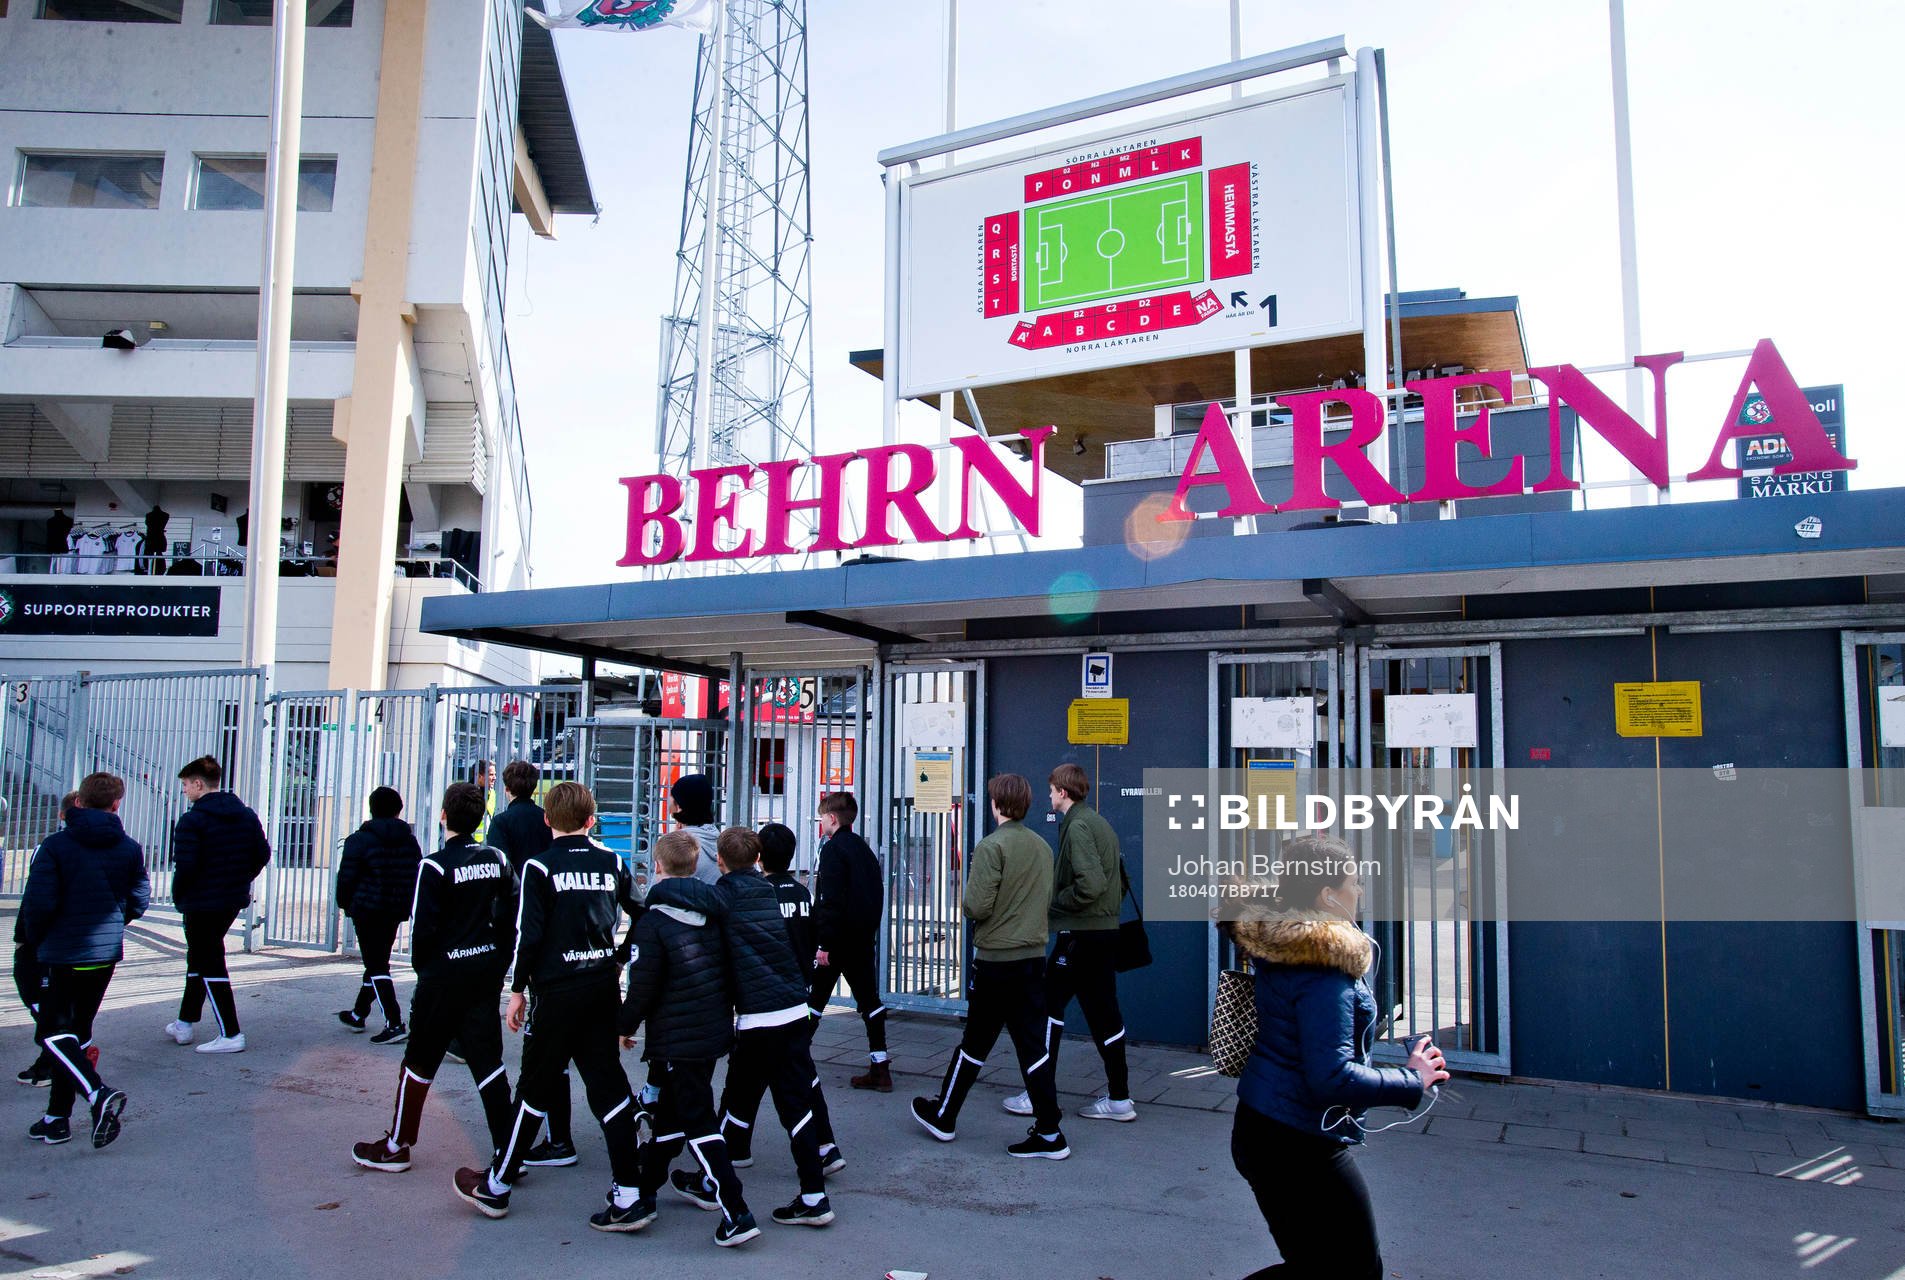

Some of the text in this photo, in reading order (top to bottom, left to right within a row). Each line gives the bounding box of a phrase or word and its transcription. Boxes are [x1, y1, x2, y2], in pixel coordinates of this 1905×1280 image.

[1035, 149, 1191, 192] P O N M L K
[992, 223, 1001, 234] Q
[1224, 183, 1240, 260] HEMMASTÅ
[992, 249, 1000, 259] R
[993, 274, 1000, 285] S
[993, 299, 1000, 309] T
[1074, 299, 1151, 319] B2 C2 D2
[1195, 297, 1218, 315] NA
[1259, 294, 1277, 328] 1
[1043, 326, 1053, 337] A
[1076, 325, 1085, 336] B
[1106, 320, 1116, 331] C
[1140, 315, 1150, 326] D
[1173, 305, 1181, 316] E
[1066, 343, 1101, 354] NORRA
[615, 337, 1858, 568] BEHRN ARENA
[1751, 471, 1833, 485] SALONG
[1751, 479, 1833, 499] MARKU
[24, 603, 211, 618] SUPPORTERPRODUKTER
[16, 683, 29, 703] 3
[799, 680, 814, 709] 5
[374, 699, 384, 723] 4
[1120, 787, 1163, 797] EYRAVALLEN
[453, 863, 501, 885] ARONSSON
[552, 872, 616, 893] KALLE.B
[447, 944, 490, 961] VÄRNAMO
[562, 949, 605, 963] VÄRNAMO
